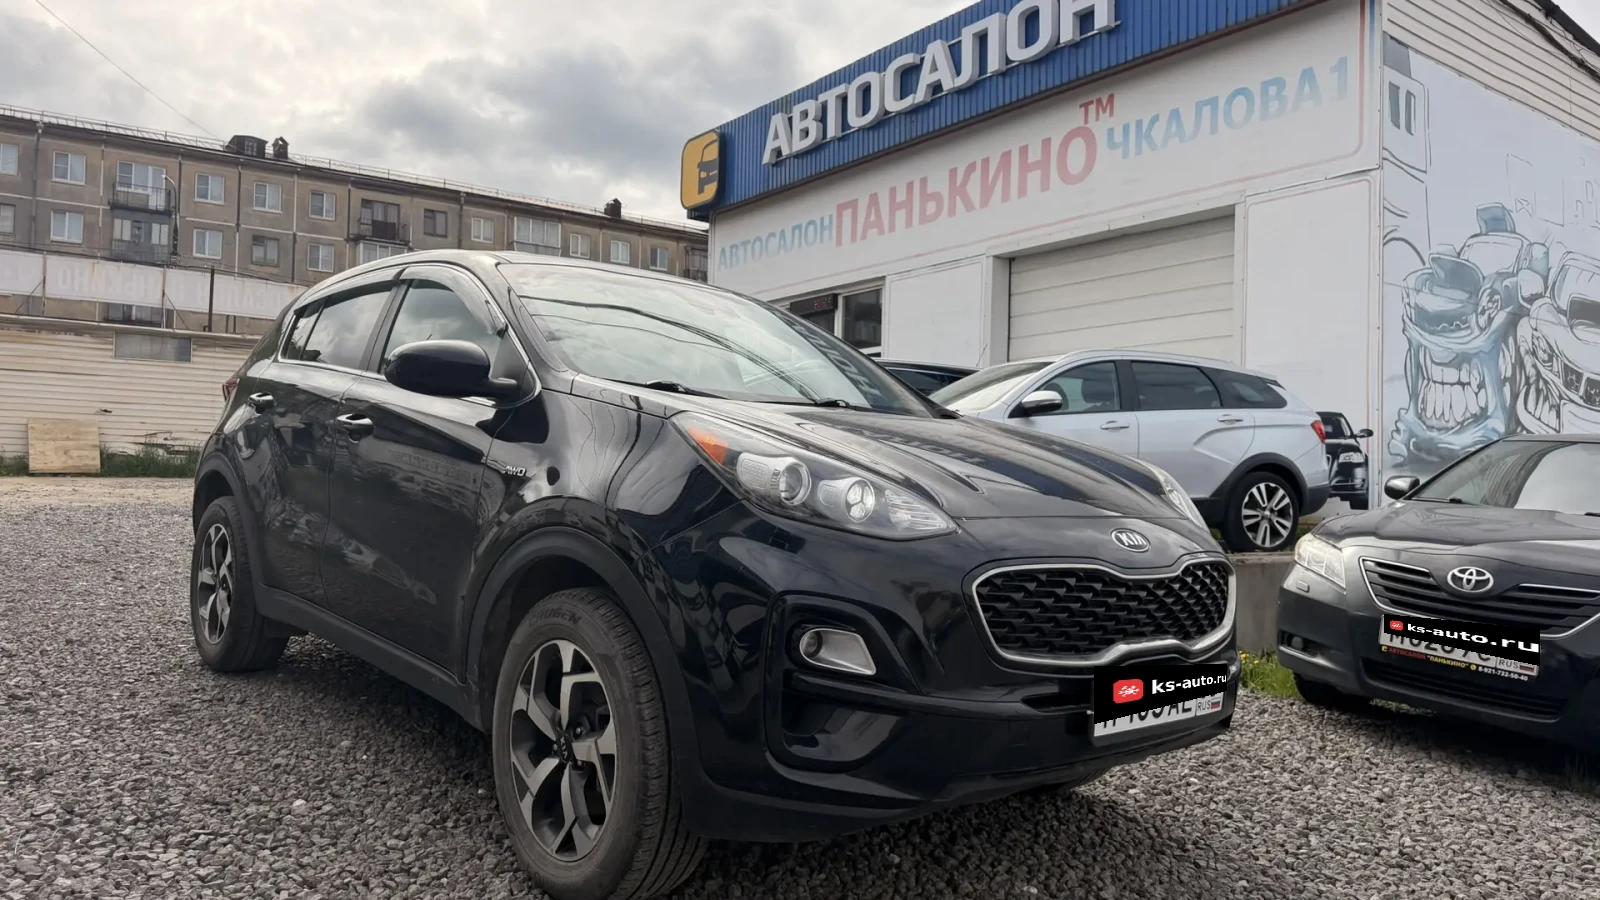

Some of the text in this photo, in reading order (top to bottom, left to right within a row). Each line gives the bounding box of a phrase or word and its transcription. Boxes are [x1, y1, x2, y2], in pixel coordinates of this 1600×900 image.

[763, 0, 1119, 165] АВТОСАЛОН
[717, 213, 834, 272] АВТОСАЛОН
[835, 125, 1098, 247] ПАНЬКИНО
[1106, 66, 1322, 160] ЧКАЛОВА
[1329, 56, 1349, 100] 1
[1116, 532, 1147, 546] KIA
[1498, 659, 1519, 669] RUS
